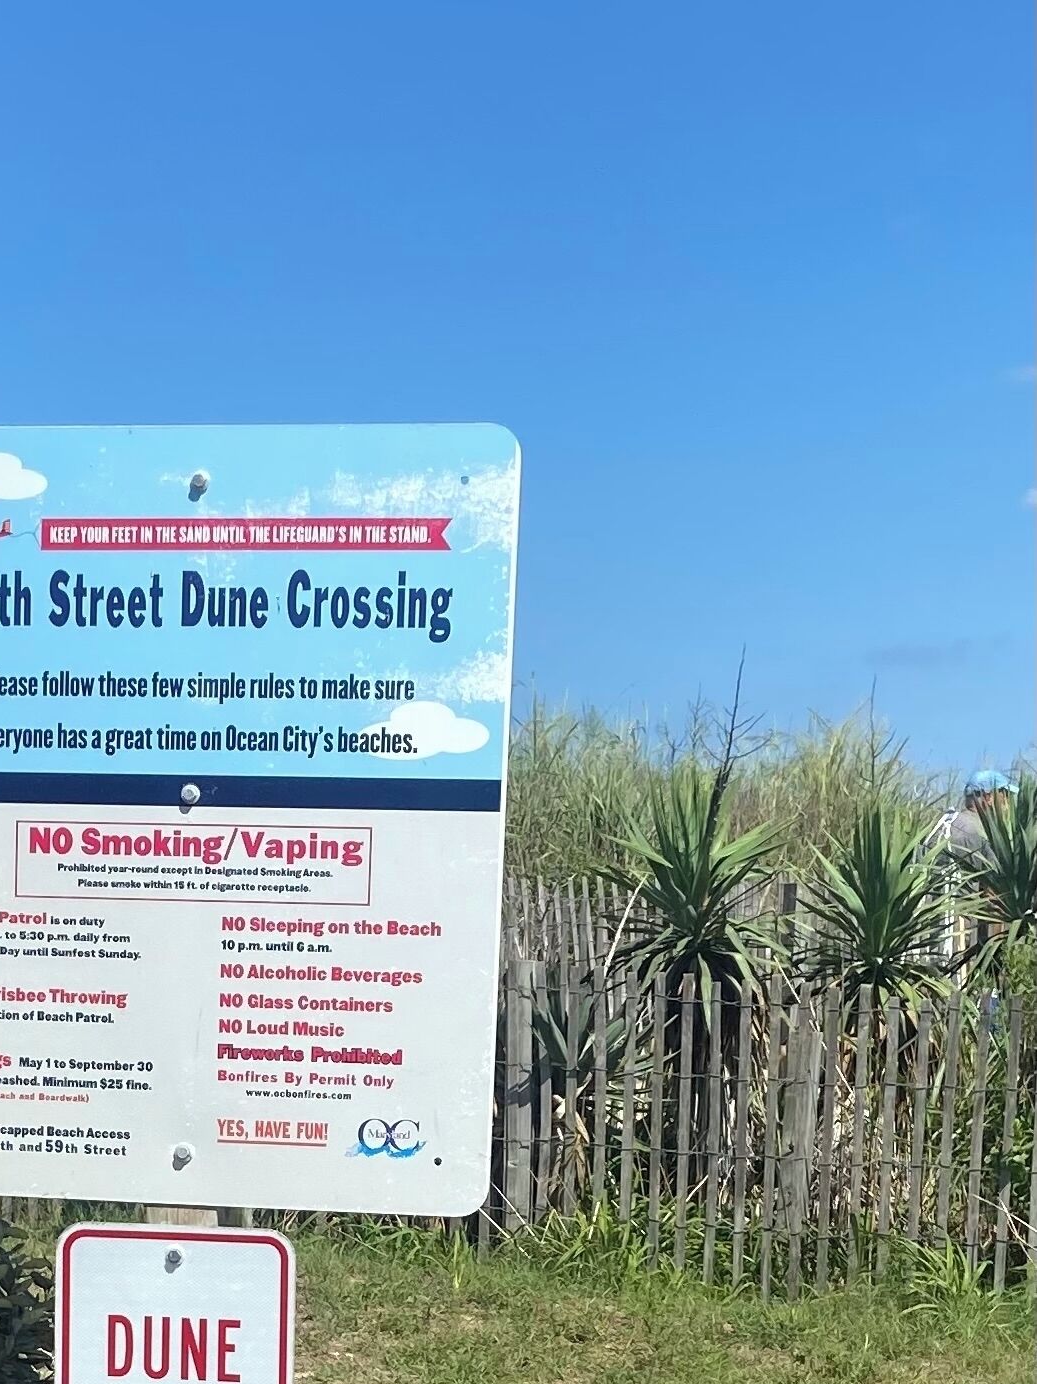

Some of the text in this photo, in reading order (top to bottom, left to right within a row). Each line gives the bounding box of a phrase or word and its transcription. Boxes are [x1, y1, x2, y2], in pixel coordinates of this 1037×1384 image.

[50, 526, 431, 543] KEEP YOUR FEET IN THE SAND UNTIL THE LIFEGUARD'S IN THE STAND.
[48, 569, 163, 628] Street
[181, 571, 268, 628] Dune
[287, 569, 453, 643] Crossing
[42, 671, 95, 696] follow
[98, 671, 147, 697] these
[152, 671, 184, 697] few
[187, 672, 245, 704] simple
[250, 673, 294, 698] rules
[299, 676, 317, 699] to
[322, 673, 370, 700] make
[375, 680, 414, 700] sure
[58, 723, 87, 749] has
[91, 729, 101, 749] a
[105, 728, 152, 755] great
[156, 724, 196, 750] time
[200, 730, 222, 750] on
[226, 725, 278, 751] Ocean
[338, 726, 418, 753] beaches.
[29, 827, 364, 866] NO Smoking/Vaping
[58, 863, 333, 878] Prohibited year-round except in Designated Smoking Areas.
[78, 879, 311, 893] Please smoke within 15 ft. of cigarette receptacle.
[51, 916, 60, 925] is
[79, 917, 105, 928] duty
[222, 916, 441, 937] NO Sleeping on the Beach
[5, 931, 16, 939] to
[19, 931, 44, 940] 5:30
[47, 933, 70, 942] p.m.
[73, 933, 99, 944] daily
[102, 933, 130, 943] from
[0, 946, 20, 957] Day
[23, 947, 48, 956] until
[51, 948, 96, 957] Sunfest
[98, 949, 141, 961] Sunday.
[221, 940, 332, 953] 10 p.m. until 6 a.m.
[220, 964, 423, 986] NO Alcoholic Beverages
[49, 988, 128, 1009] Throwing
[220, 993, 393, 1012] NO Glass Containers
[22, 1010, 34, 1020] of
[37, 1011, 73, 1021] Beach
[75, 1012, 114, 1023] Patrol.
[219, 1019, 344, 1037] NO Loud Music
[218, 1044, 402, 1065] Fireworks Prohibited
[19, 1057, 42, 1070] May
[46, 1059, 51, 1068] 1
[54, 1059, 66, 1069] to
[69, 1059, 135, 1072] September
[137, 1061, 153, 1071] 30
[43, 1076, 97, 1088] Minimum
[100, 1078, 123, 1090] $25
[126, 1079, 152, 1090] fine.
[218, 1070, 394, 1089] Bonfires By Permit Only
[39, 1093, 89, 1103] Boardwalk)
[246, 1089, 352, 1100] www.ocbonfires.com
[47, 1126, 84, 1138] Beach
[86, 1128, 130, 1139] Access
[217, 1119, 328, 1140] YES, HAVE FUN!
[358, 1119, 419, 1151] OC
[19, 1141, 42, 1152] and
[45, 1140, 78, 1153] 59th
[84, 1144, 127, 1156] Street
[107, 1314, 241, 1382] DUNE
